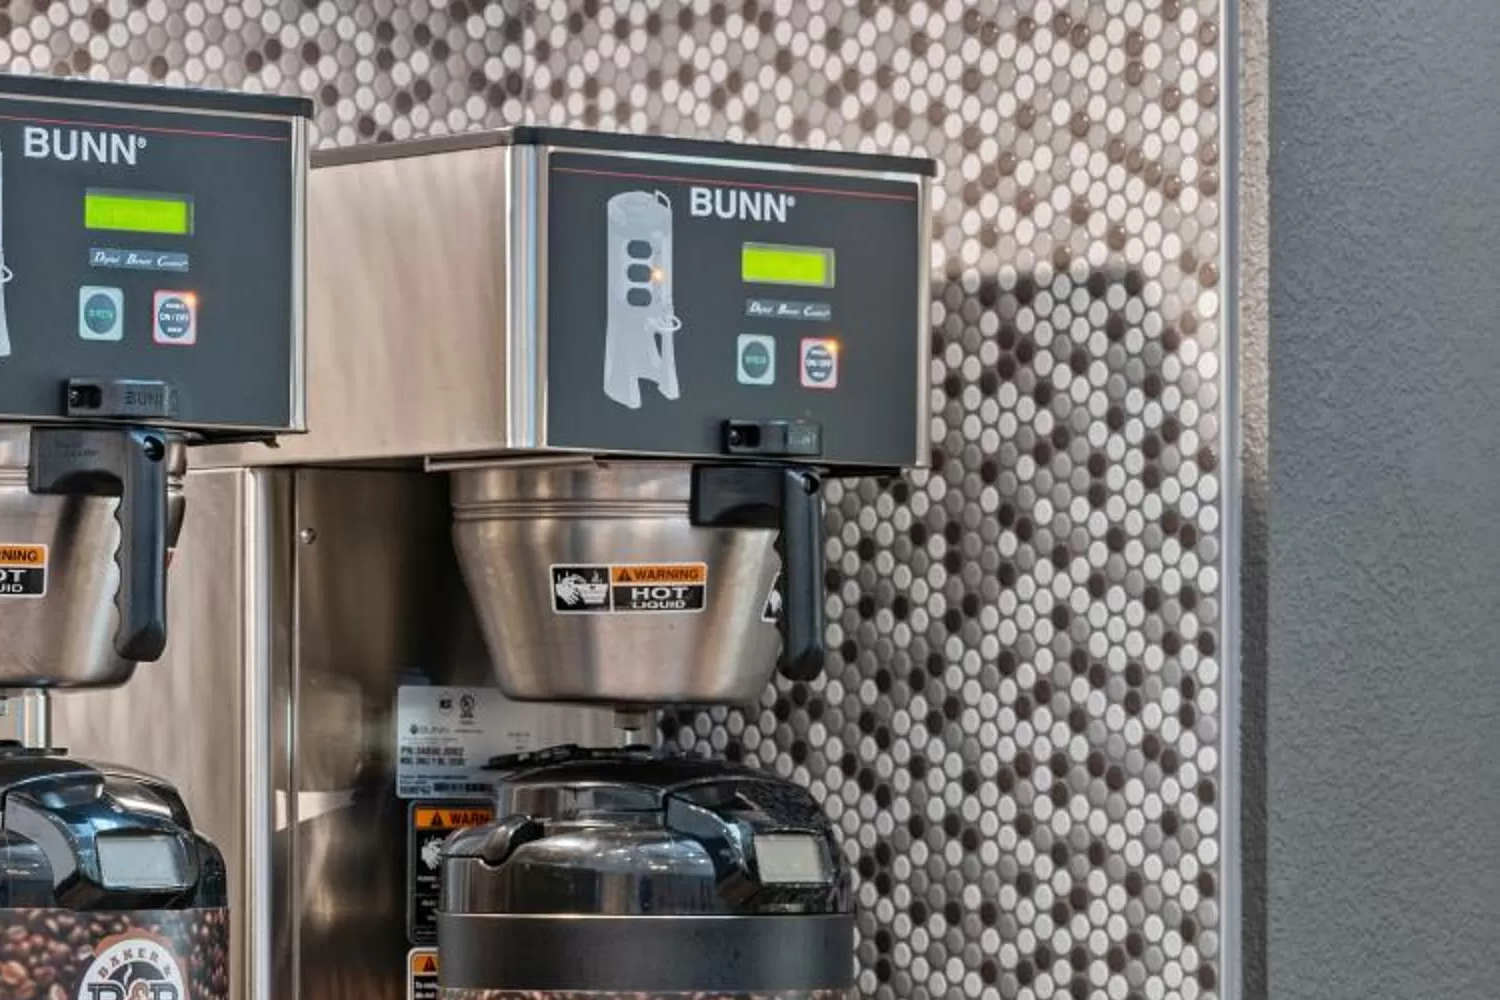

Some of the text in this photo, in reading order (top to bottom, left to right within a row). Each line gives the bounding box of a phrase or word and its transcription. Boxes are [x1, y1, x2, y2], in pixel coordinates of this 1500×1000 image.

[634, 568, 699, 580] WARNING
[631, 587, 689, 600] HOT
[632, 600, 687, 610] LIQUID
